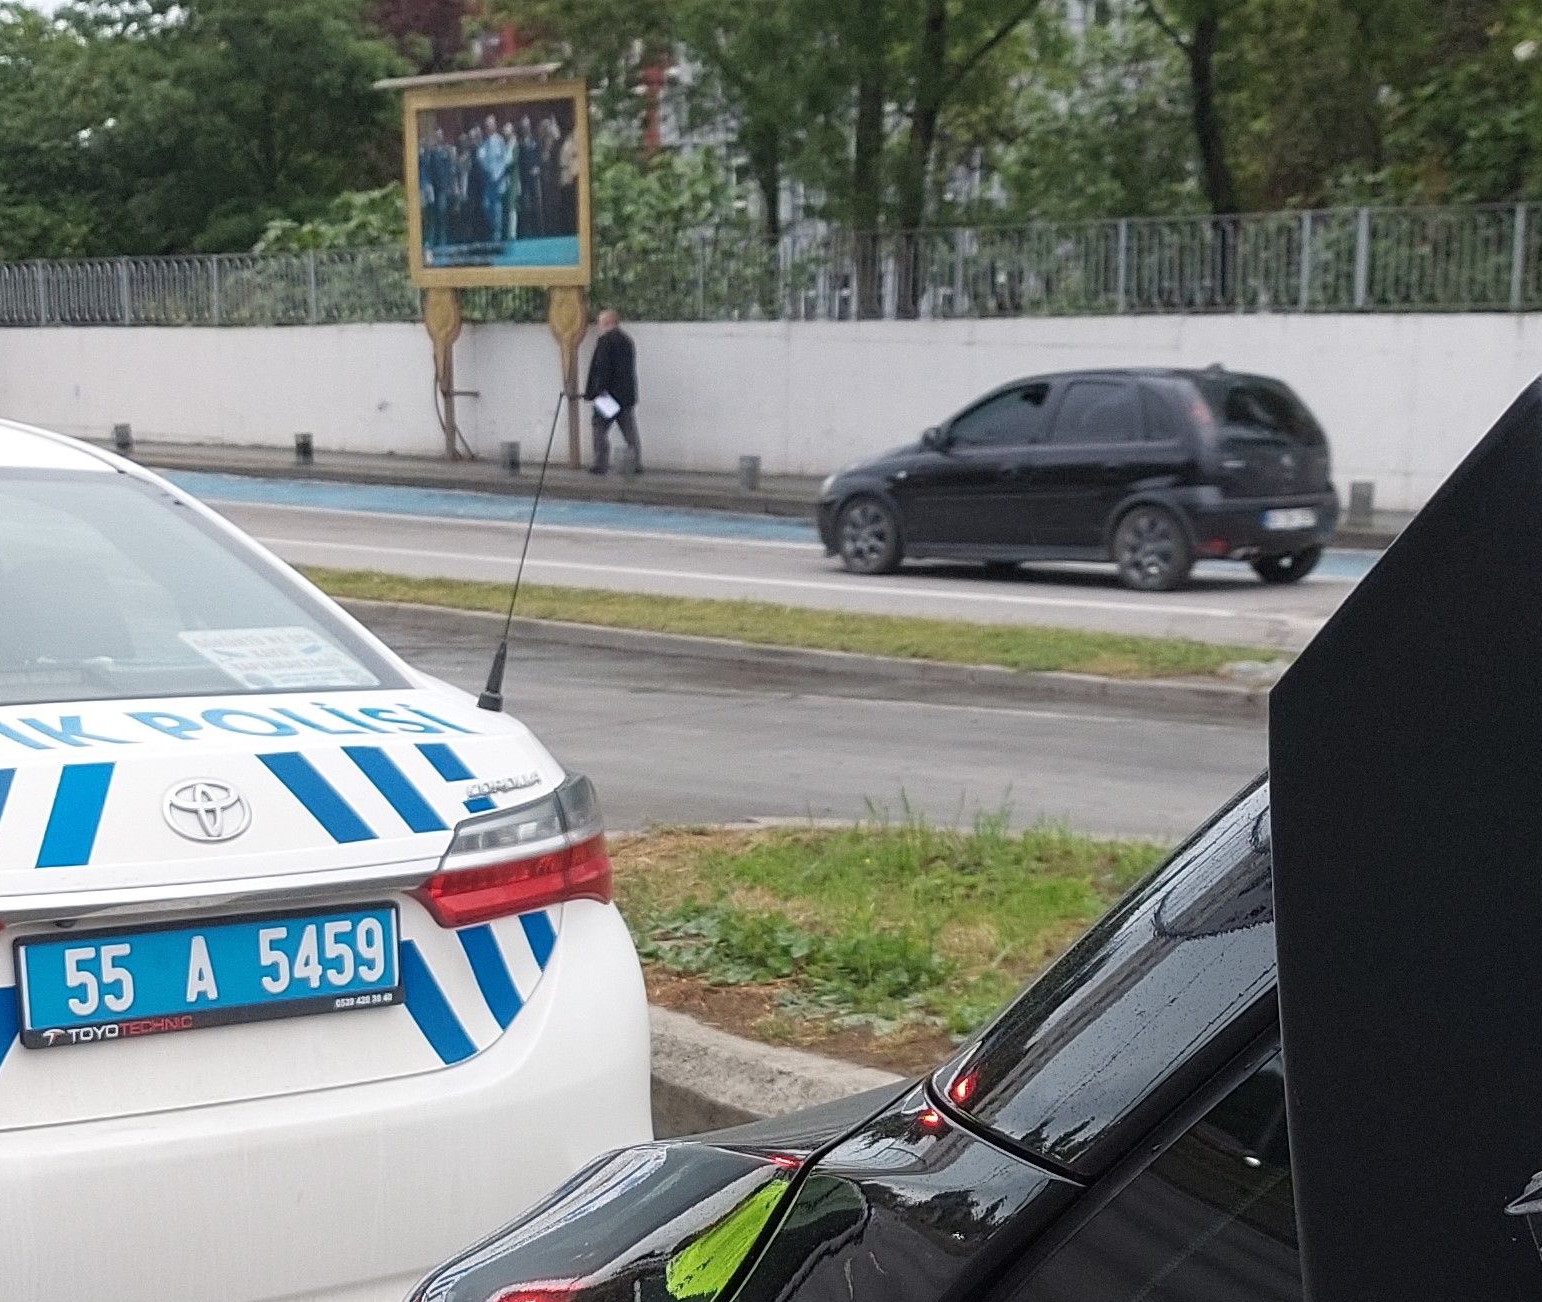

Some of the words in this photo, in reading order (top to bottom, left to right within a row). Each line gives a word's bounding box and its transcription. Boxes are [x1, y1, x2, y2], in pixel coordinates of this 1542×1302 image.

[125, 702, 479, 741] POLİSİ
[63, 943, 135, 1017] 55
[185, 935, 219, 1003] A
[259, 916, 385, 995] 5459
